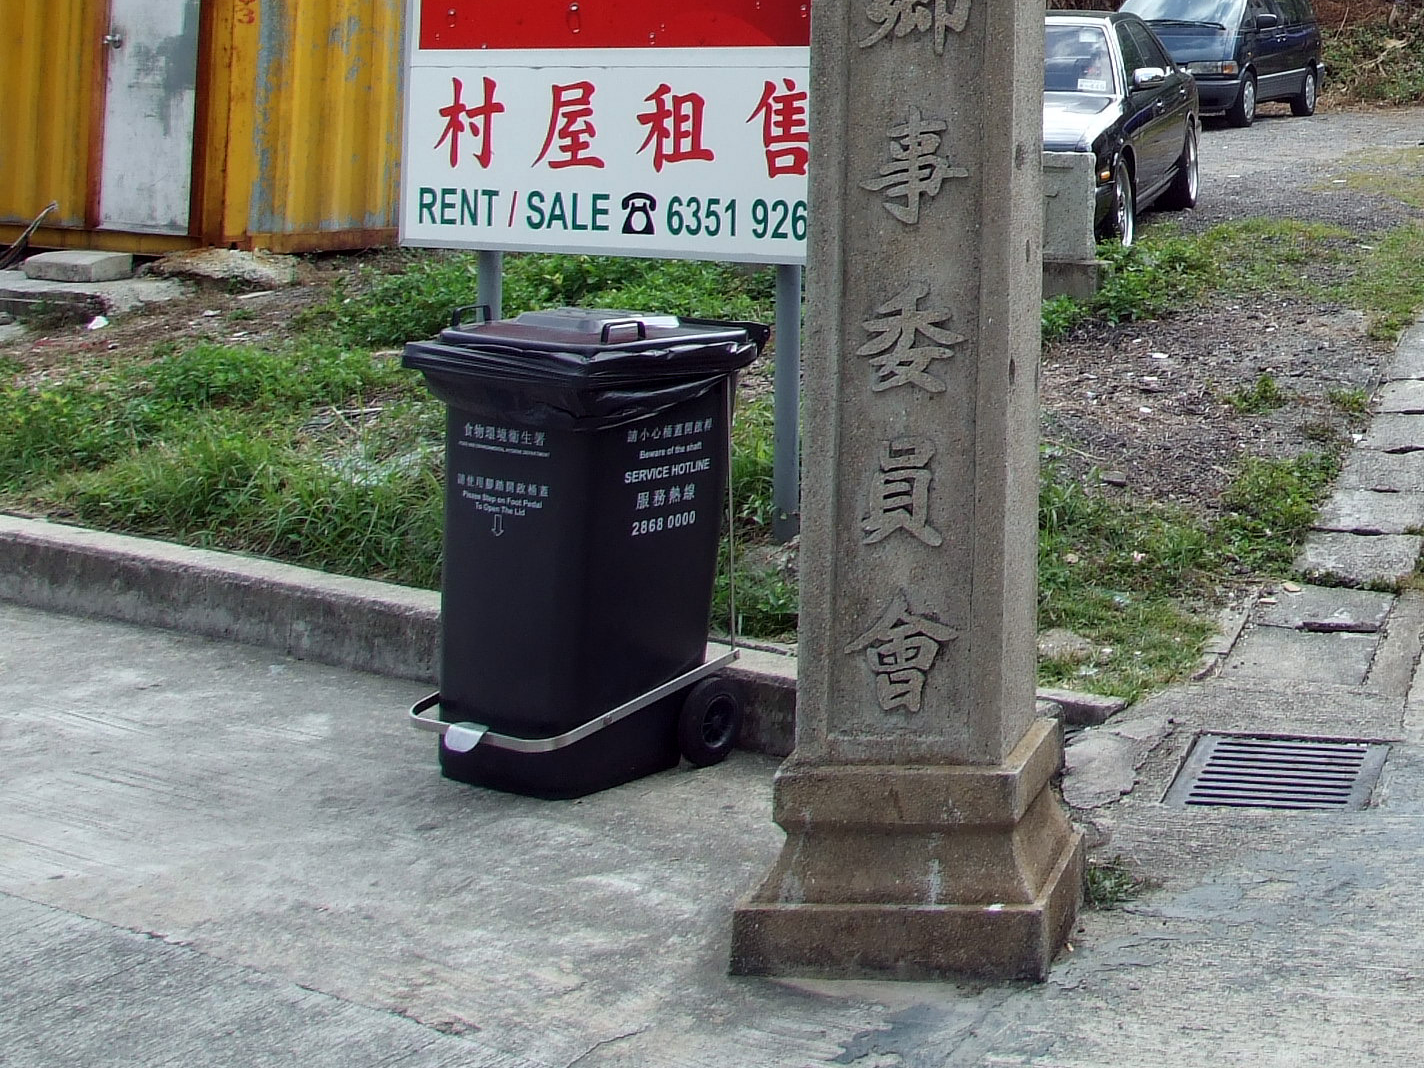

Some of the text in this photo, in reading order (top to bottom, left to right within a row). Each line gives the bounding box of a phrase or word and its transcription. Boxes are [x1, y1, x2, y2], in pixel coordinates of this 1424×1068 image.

[433, 76, 809, 179] 村屋租售
[418, 186, 499, 228] RENT
[526, 190, 610, 231] SALE
[667, 195, 737, 237] 6351
[639, 449, 665, 460] Beware
[624, 458, 711, 484] SERVICE HOTLINE
[475, 501, 483, 510] To
[514, 508, 526, 516] Lid
[635, 482, 696, 510] 服務熱線
[631, 510, 696, 536] 2868 0000
